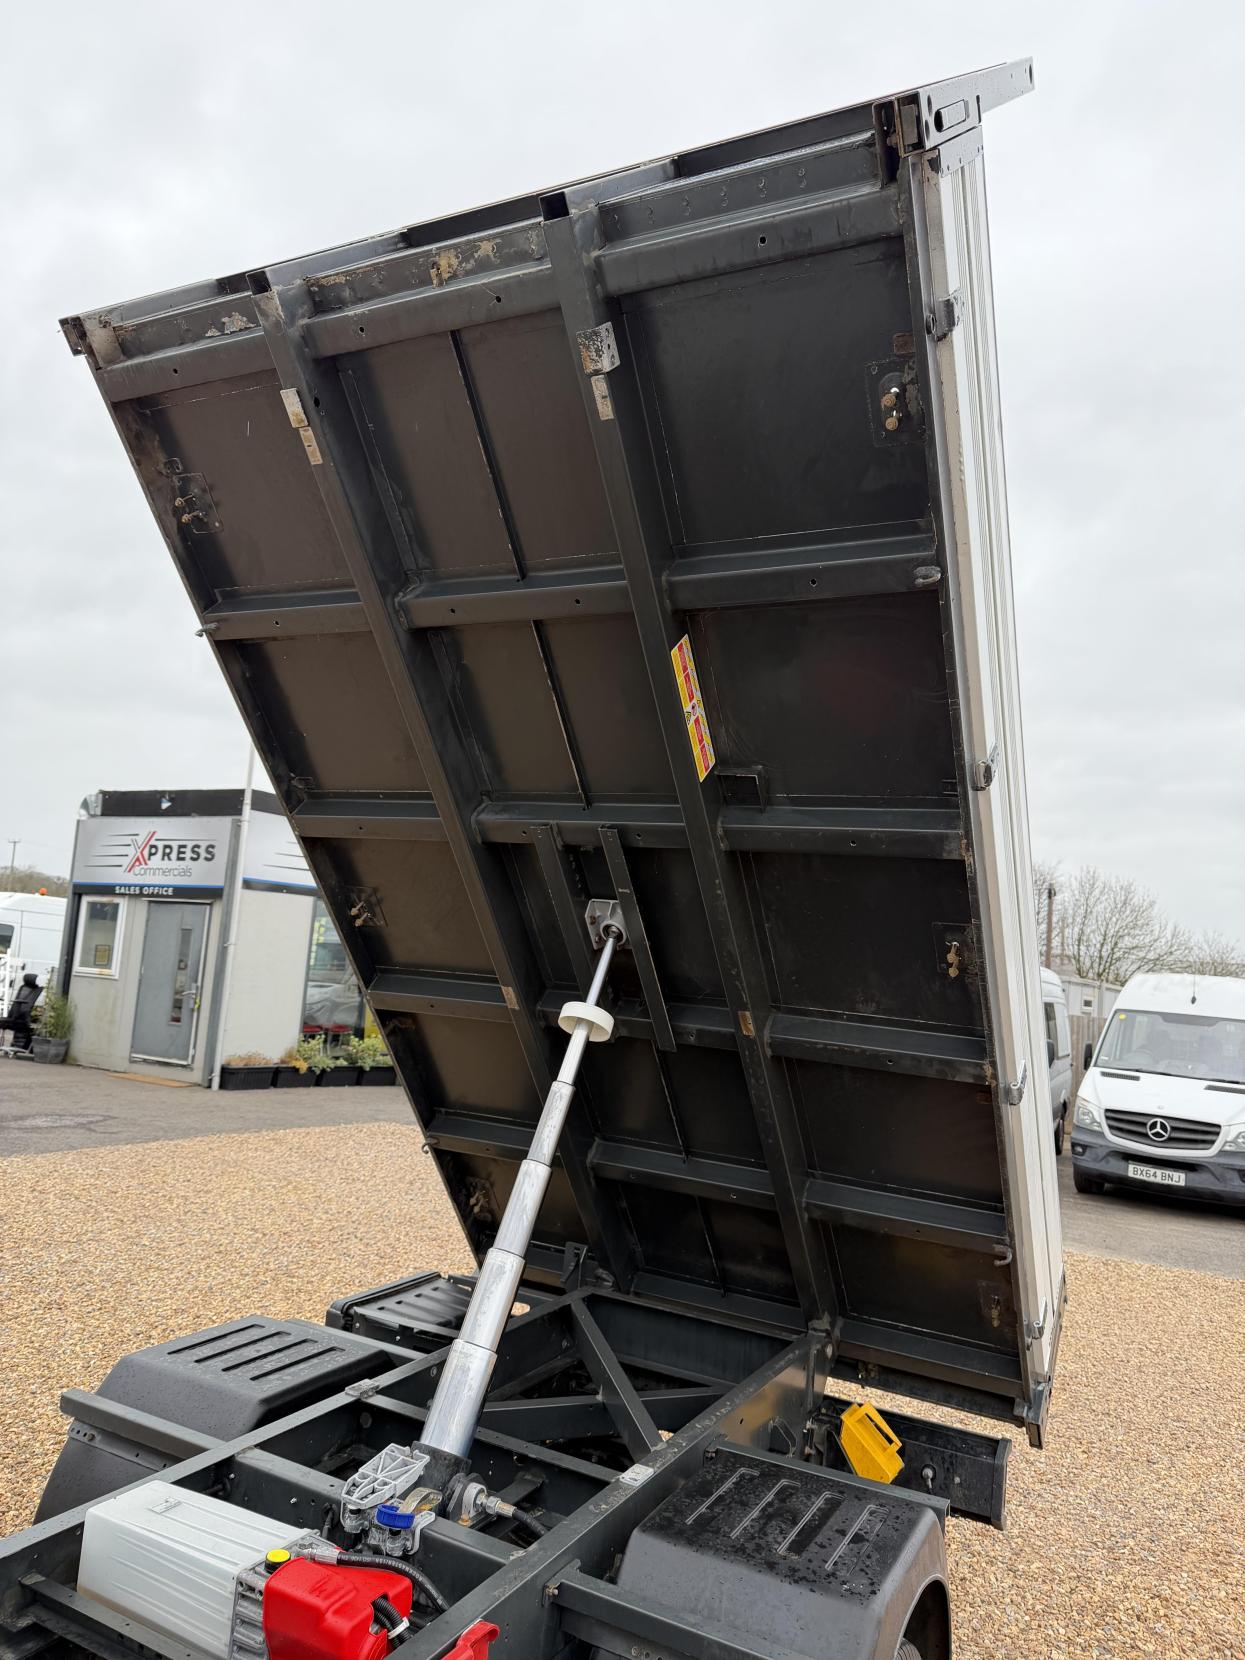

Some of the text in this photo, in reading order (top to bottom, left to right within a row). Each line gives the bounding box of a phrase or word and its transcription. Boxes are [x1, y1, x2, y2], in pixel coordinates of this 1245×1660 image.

[123, 830, 217, 873] XPRESS
[132, 864, 193, 877] Commercials
[115, 886, 174, 896] SALES OFFICE
[1132, 1166, 1181, 1184] BX64 BNJ
